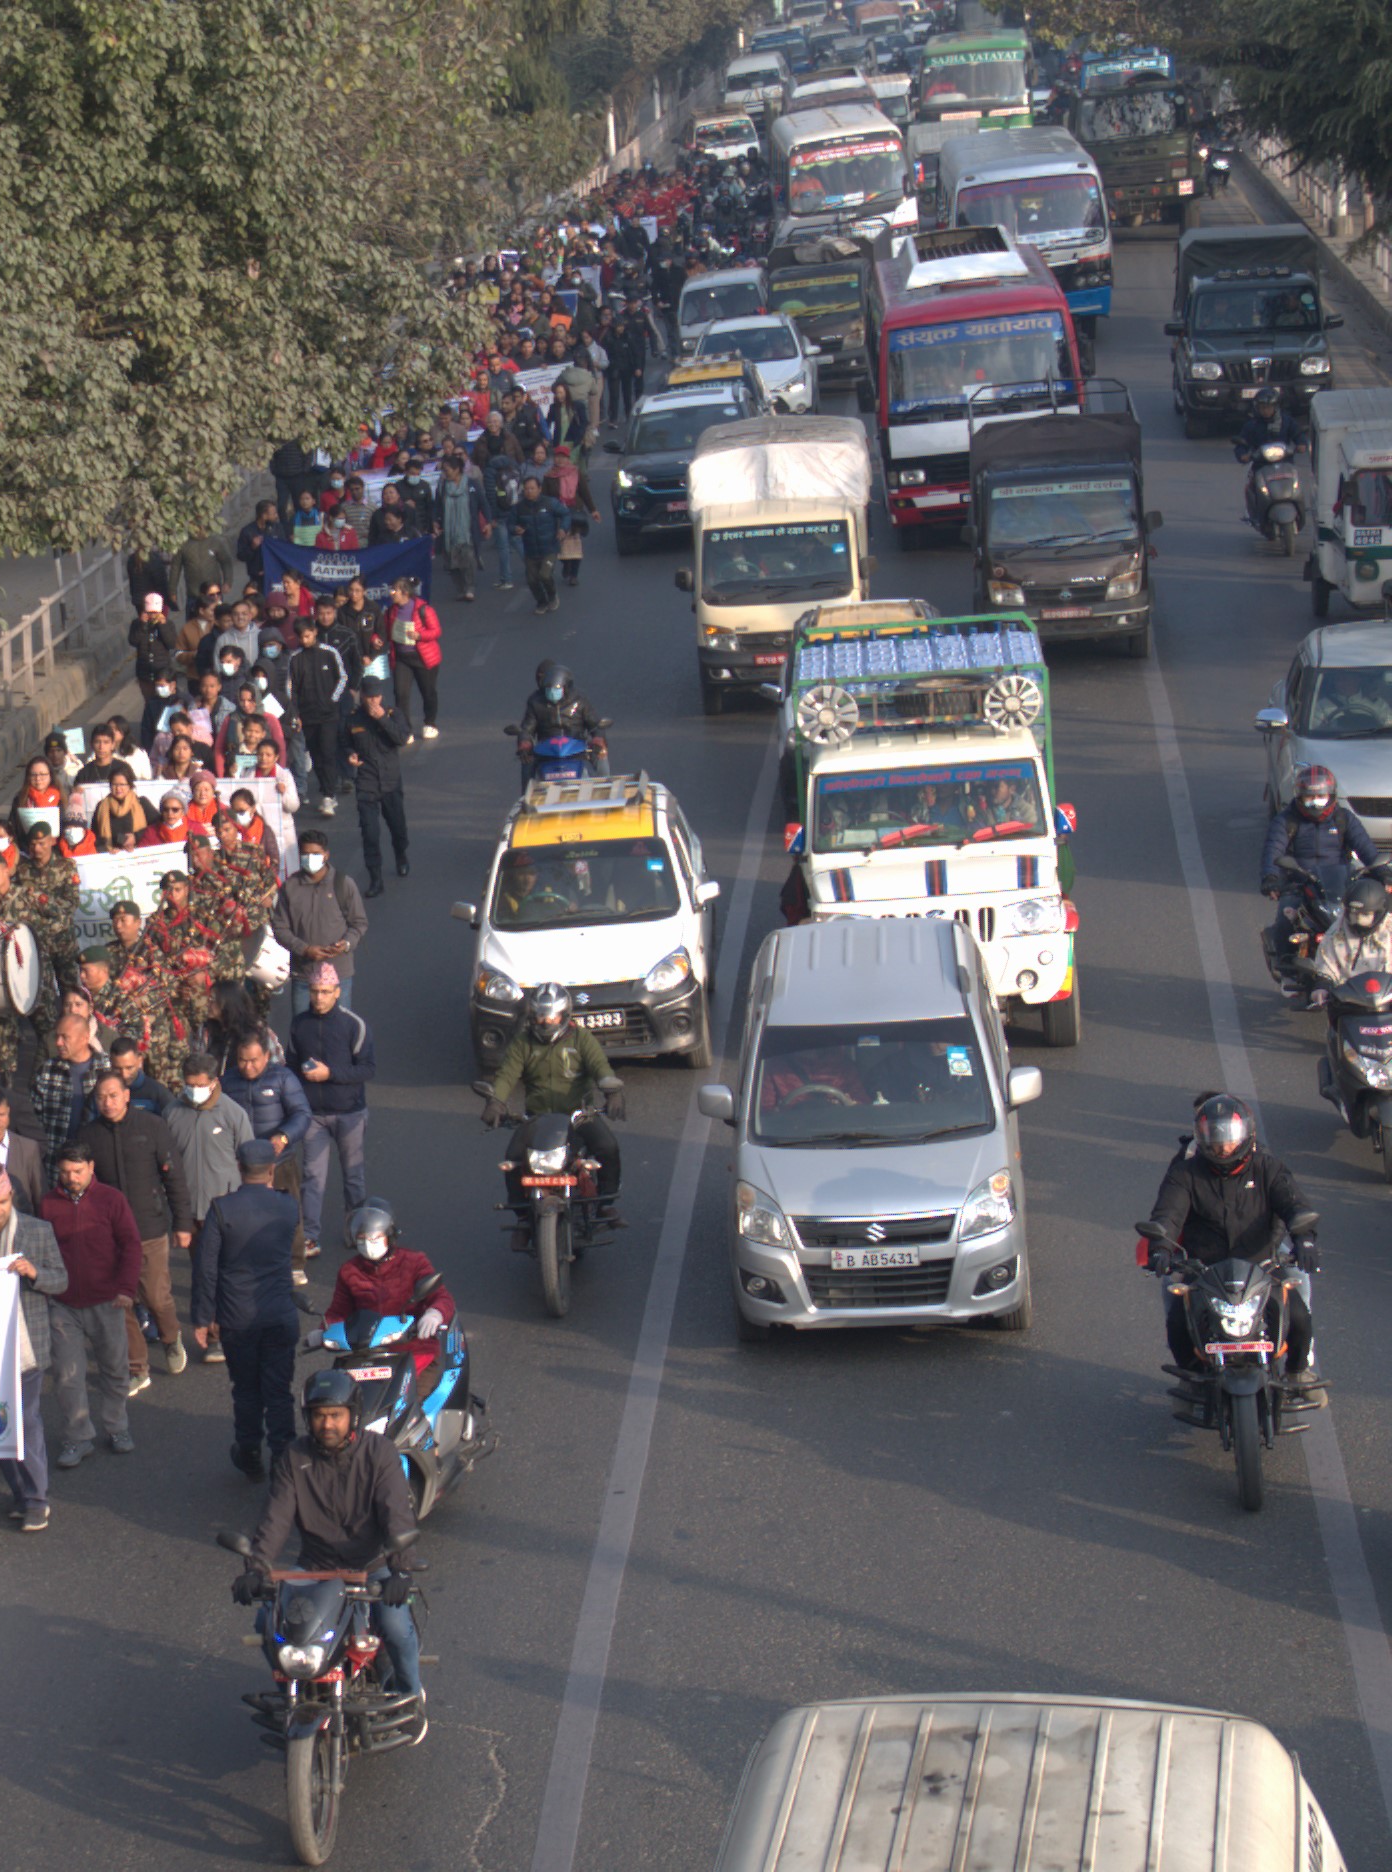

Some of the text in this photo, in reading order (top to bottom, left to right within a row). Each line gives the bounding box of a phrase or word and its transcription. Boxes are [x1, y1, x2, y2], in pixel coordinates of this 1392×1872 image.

[931, 51, 1019, 66] SAJHA YATAYAT
[896, 316, 1054, 346] संयुक्त यातायात
